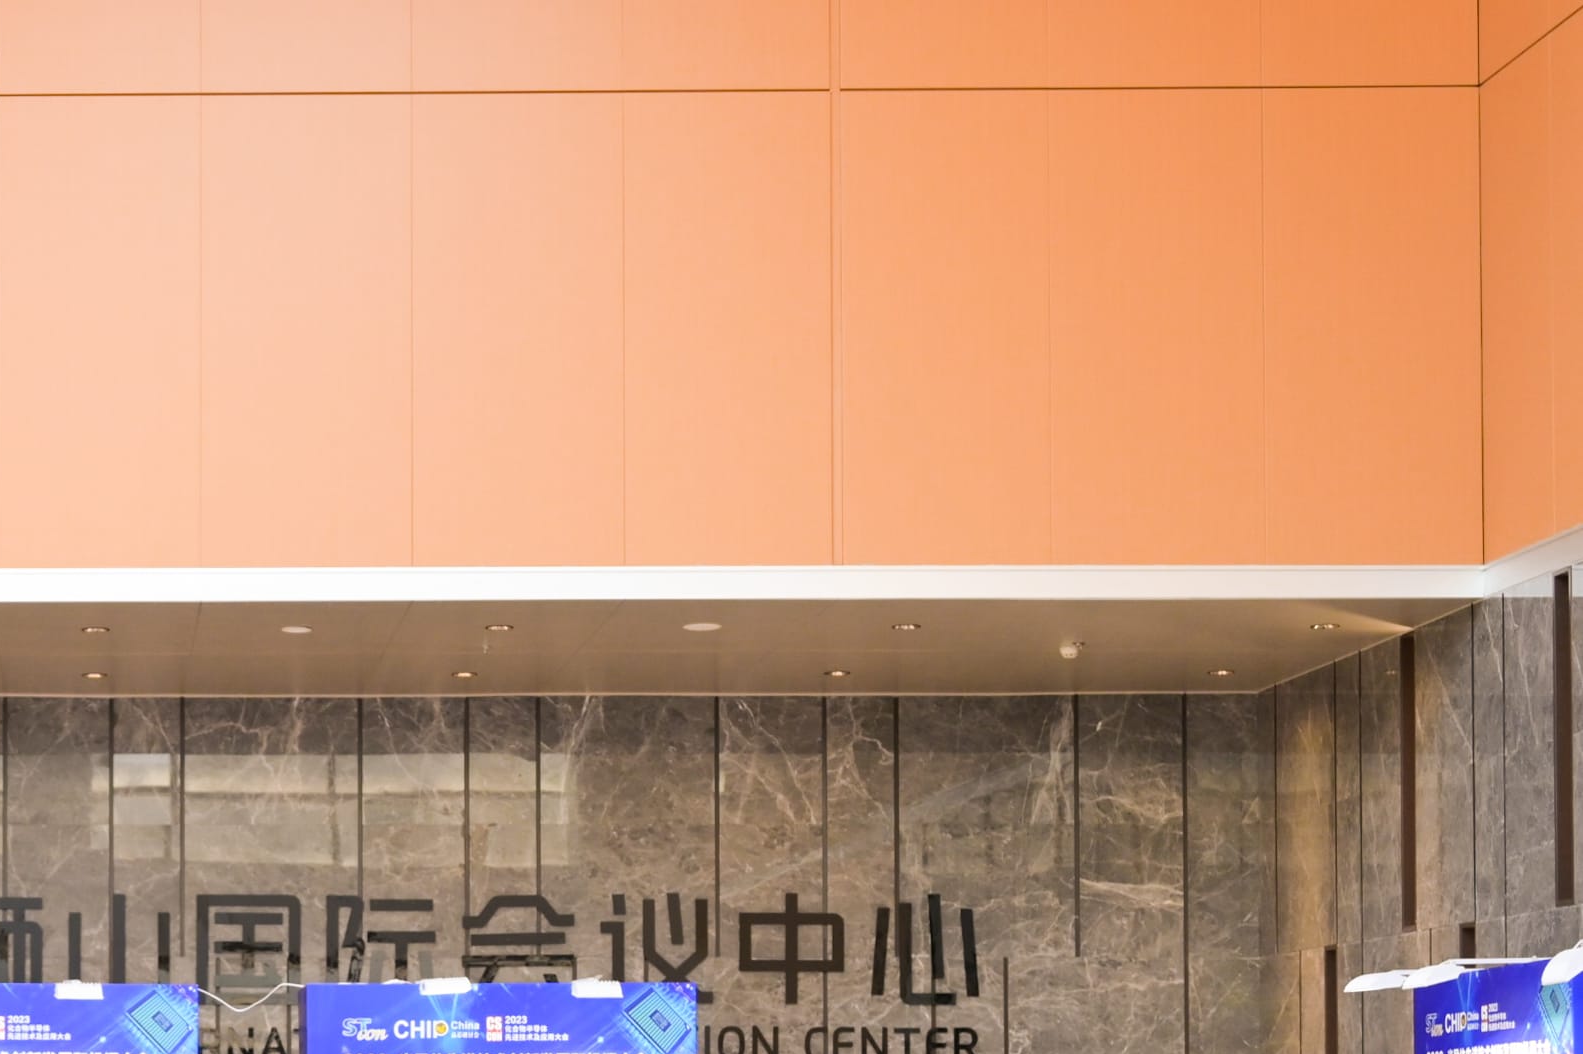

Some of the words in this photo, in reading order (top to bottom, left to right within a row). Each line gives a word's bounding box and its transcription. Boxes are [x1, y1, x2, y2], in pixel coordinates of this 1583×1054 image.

[7, 1015, 30, 1024] 2023
[486, 1016, 502, 1029] CS
[505, 1015, 528, 1024] 2023
[393, 1019, 449, 1039] CHIP
[451, 1021, 480, 1030] China
